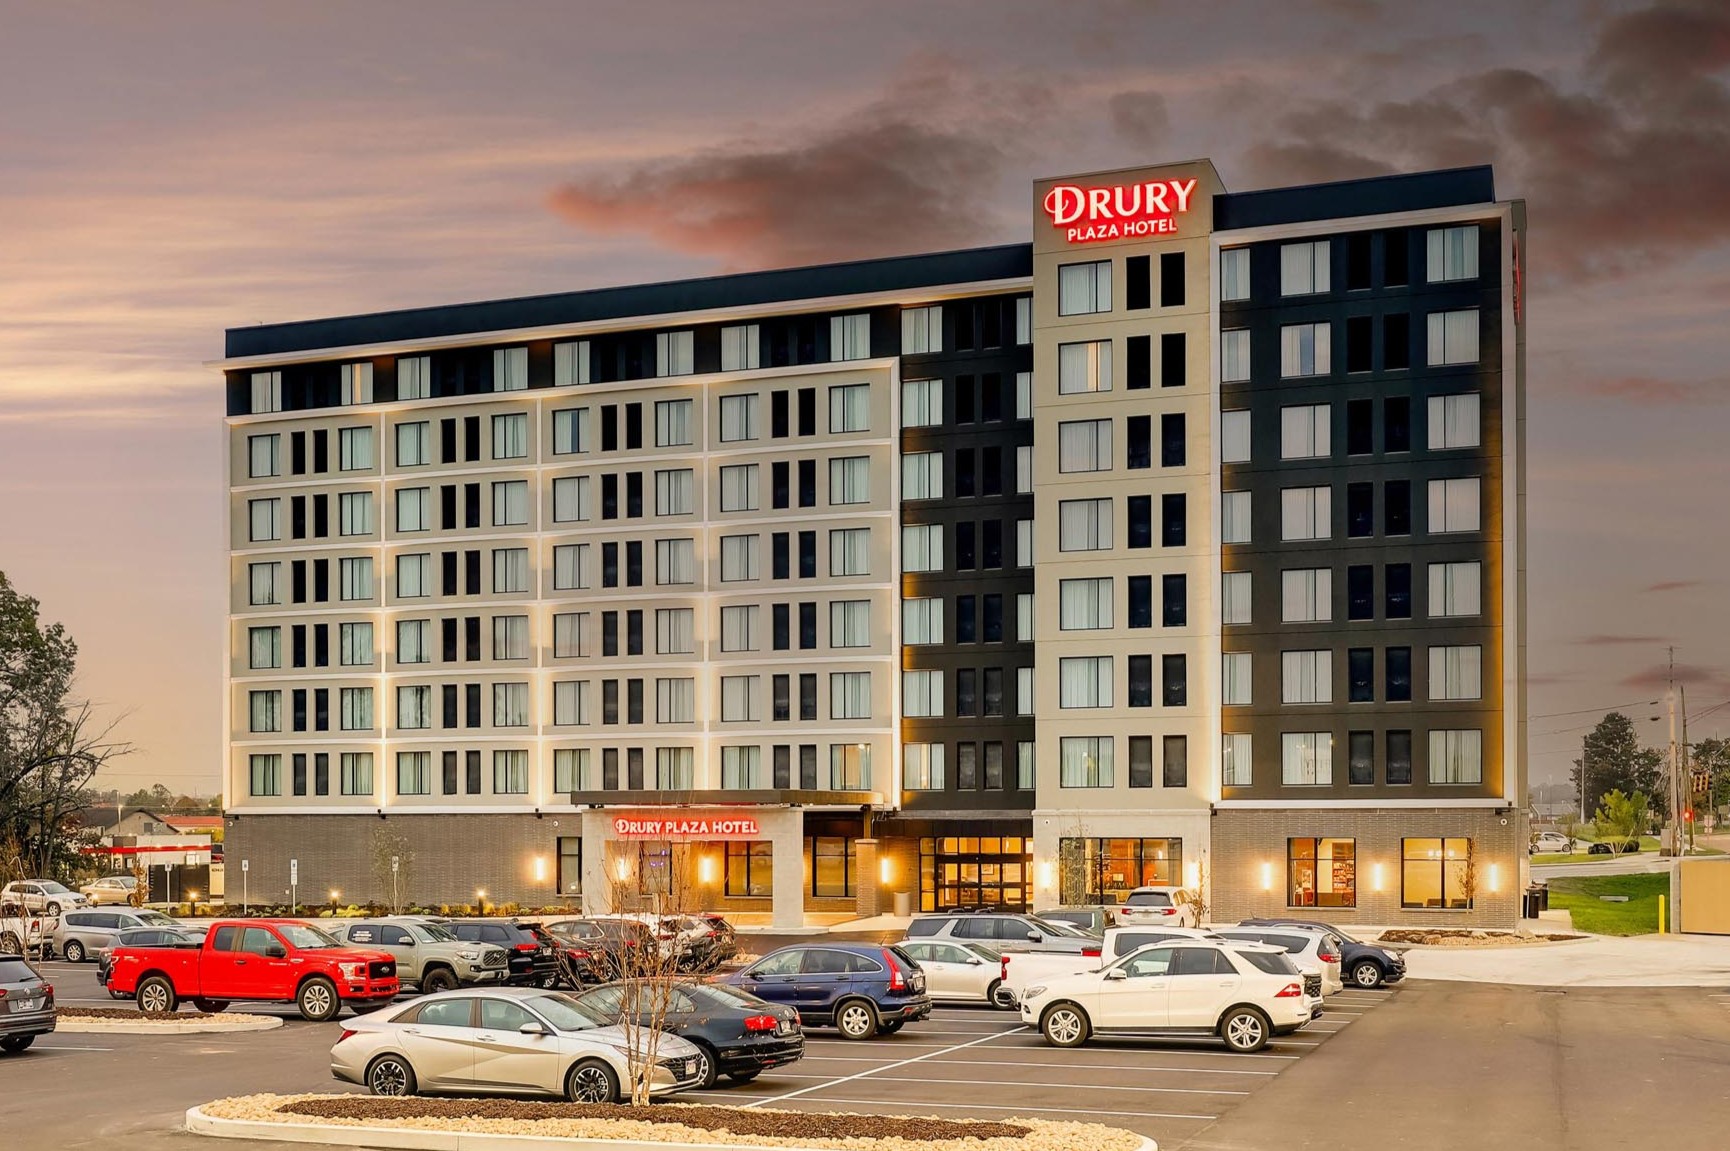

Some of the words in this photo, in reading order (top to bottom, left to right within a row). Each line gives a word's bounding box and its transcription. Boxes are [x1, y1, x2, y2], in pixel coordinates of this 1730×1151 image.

[1044, 178, 1198, 225] DRURY
[1067, 224, 1119, 242] PLAZA
[1123, 218, 1178, 236] HOTEL
[615, 818, 662, 834] DRURY
[665, 821, 709, 834] PLAZA
[712, 820, 758, 833] HOTEL
